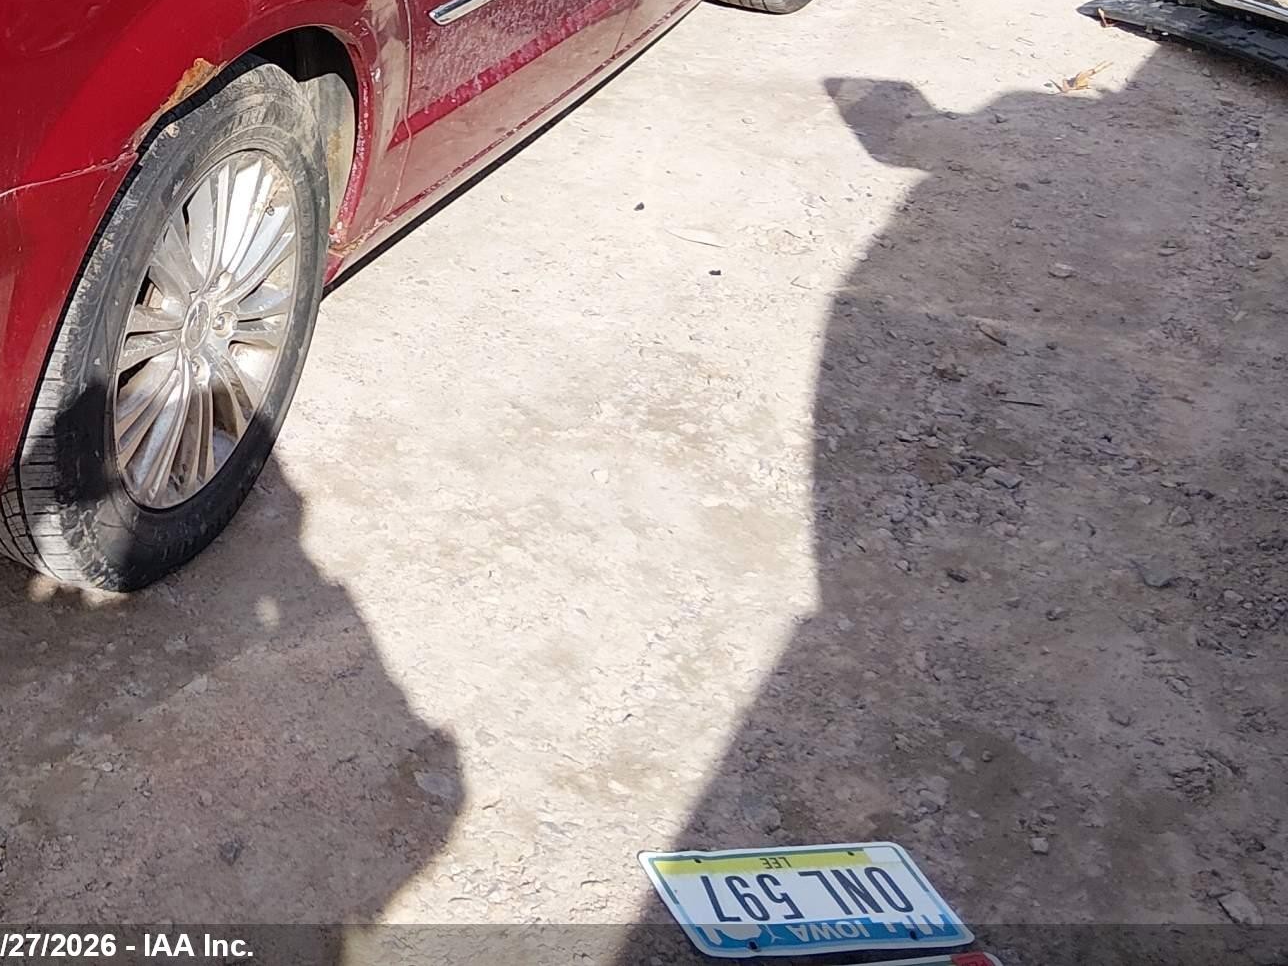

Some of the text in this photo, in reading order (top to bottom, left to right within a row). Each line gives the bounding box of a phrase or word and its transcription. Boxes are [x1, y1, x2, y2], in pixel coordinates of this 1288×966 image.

[762, 856, 791, 869] LEE
[701, 874, 804, 922] 597
[787, 920, 870, 942] IOWA
